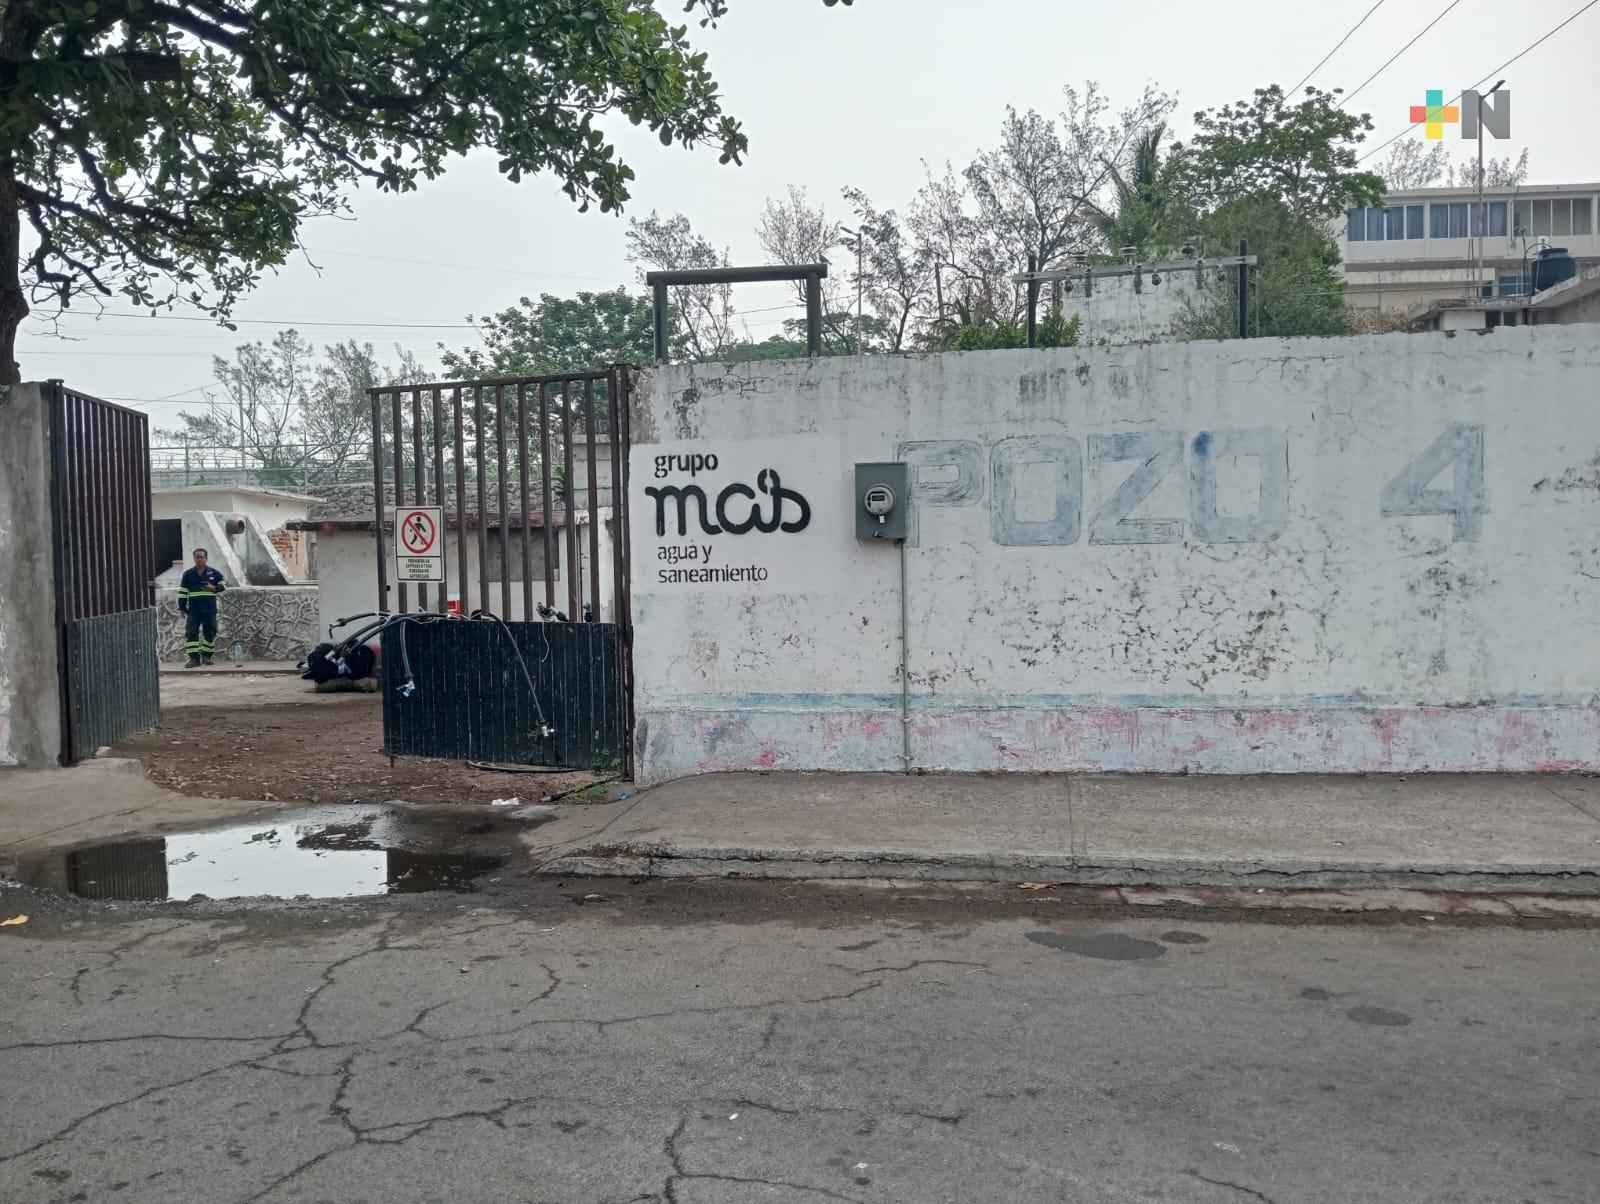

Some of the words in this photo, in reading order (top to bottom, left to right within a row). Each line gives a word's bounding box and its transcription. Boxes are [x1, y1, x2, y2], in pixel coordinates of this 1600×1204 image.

[654, 453, 719, 478] grupo
[896, 430, 1289, 547] POZO
[1380, 422, 1484, 543] 4
[657, 543, 698, 565] agua
[701, 543, 713, 563] y
[658, 564, 768, 584] saneamiento
